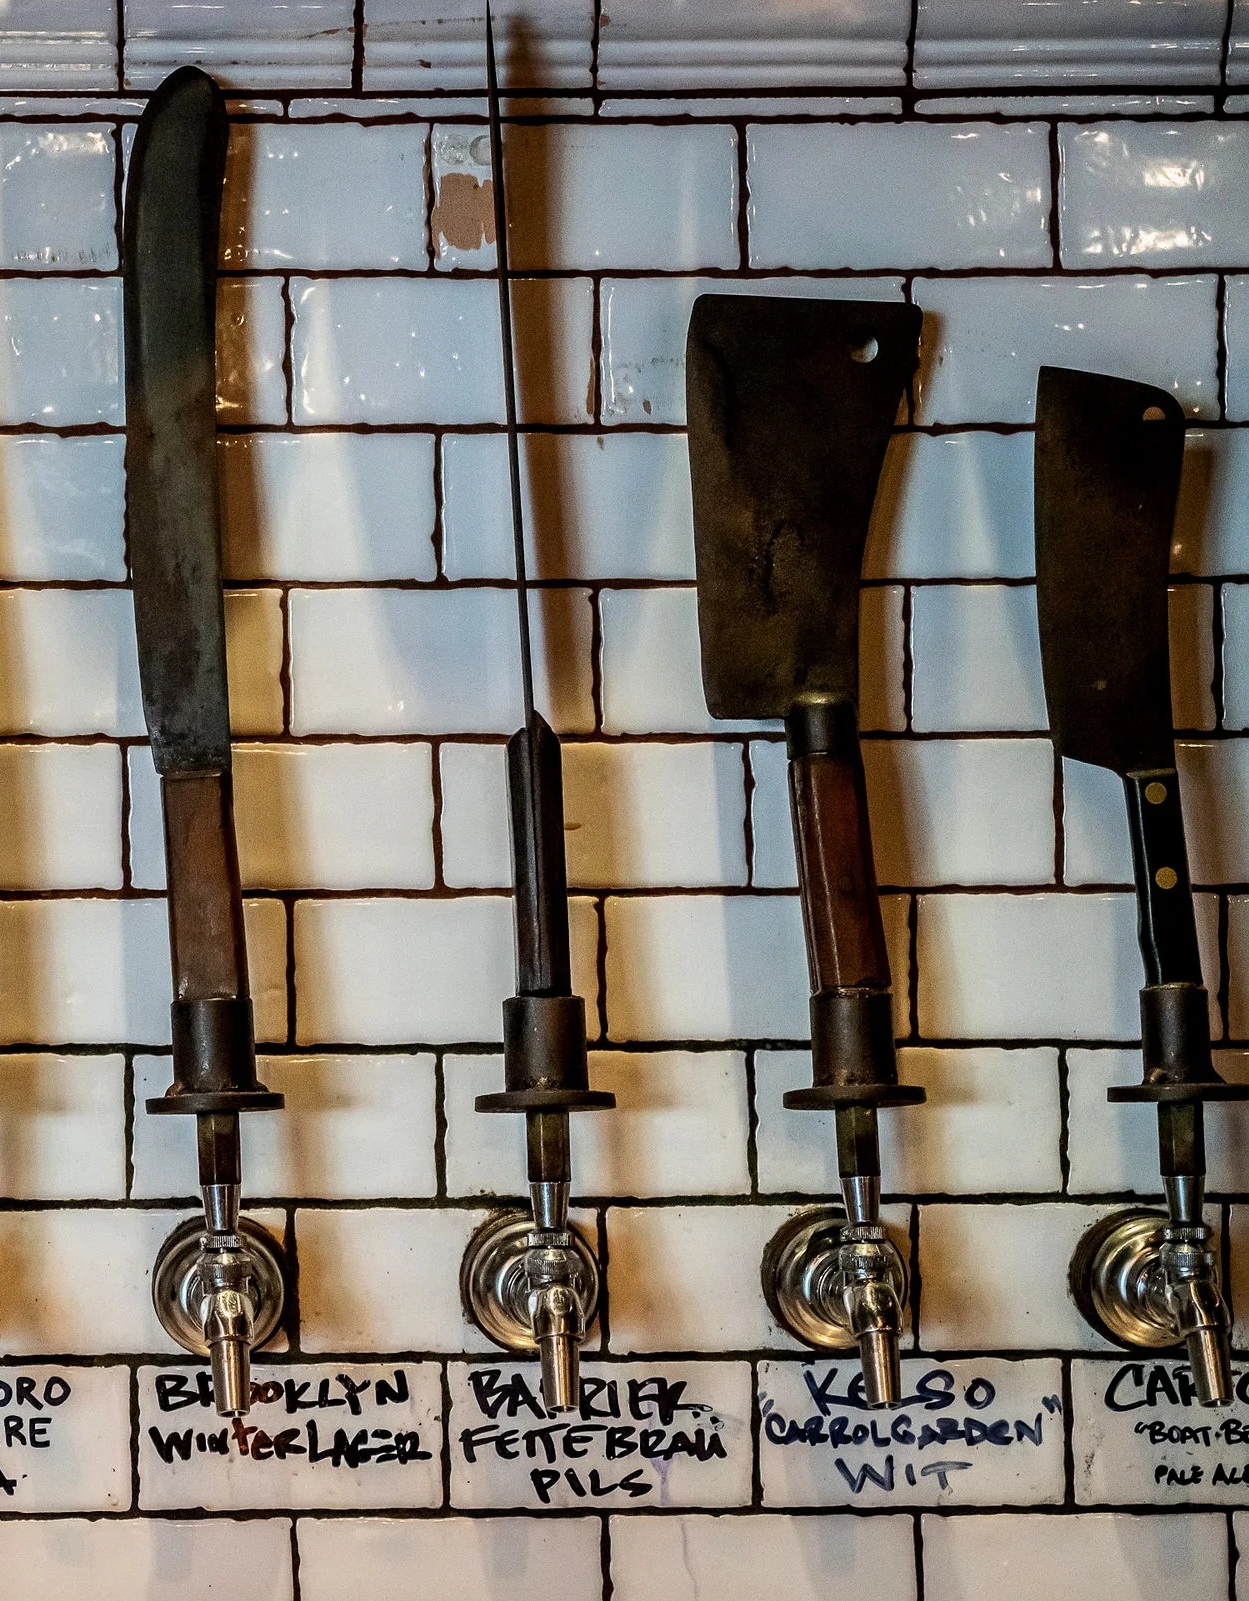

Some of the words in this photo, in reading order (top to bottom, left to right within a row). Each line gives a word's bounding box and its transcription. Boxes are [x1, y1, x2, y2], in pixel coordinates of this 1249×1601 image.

[468, 1368, 713, 1426] BARIER
[803, 1367, 996, 1416] KESO
[530, 1468, 653, 1504] PILS
[834, 1454, 973, 1494] WIT
[1155, 1464, 1204, 1486] PALE
